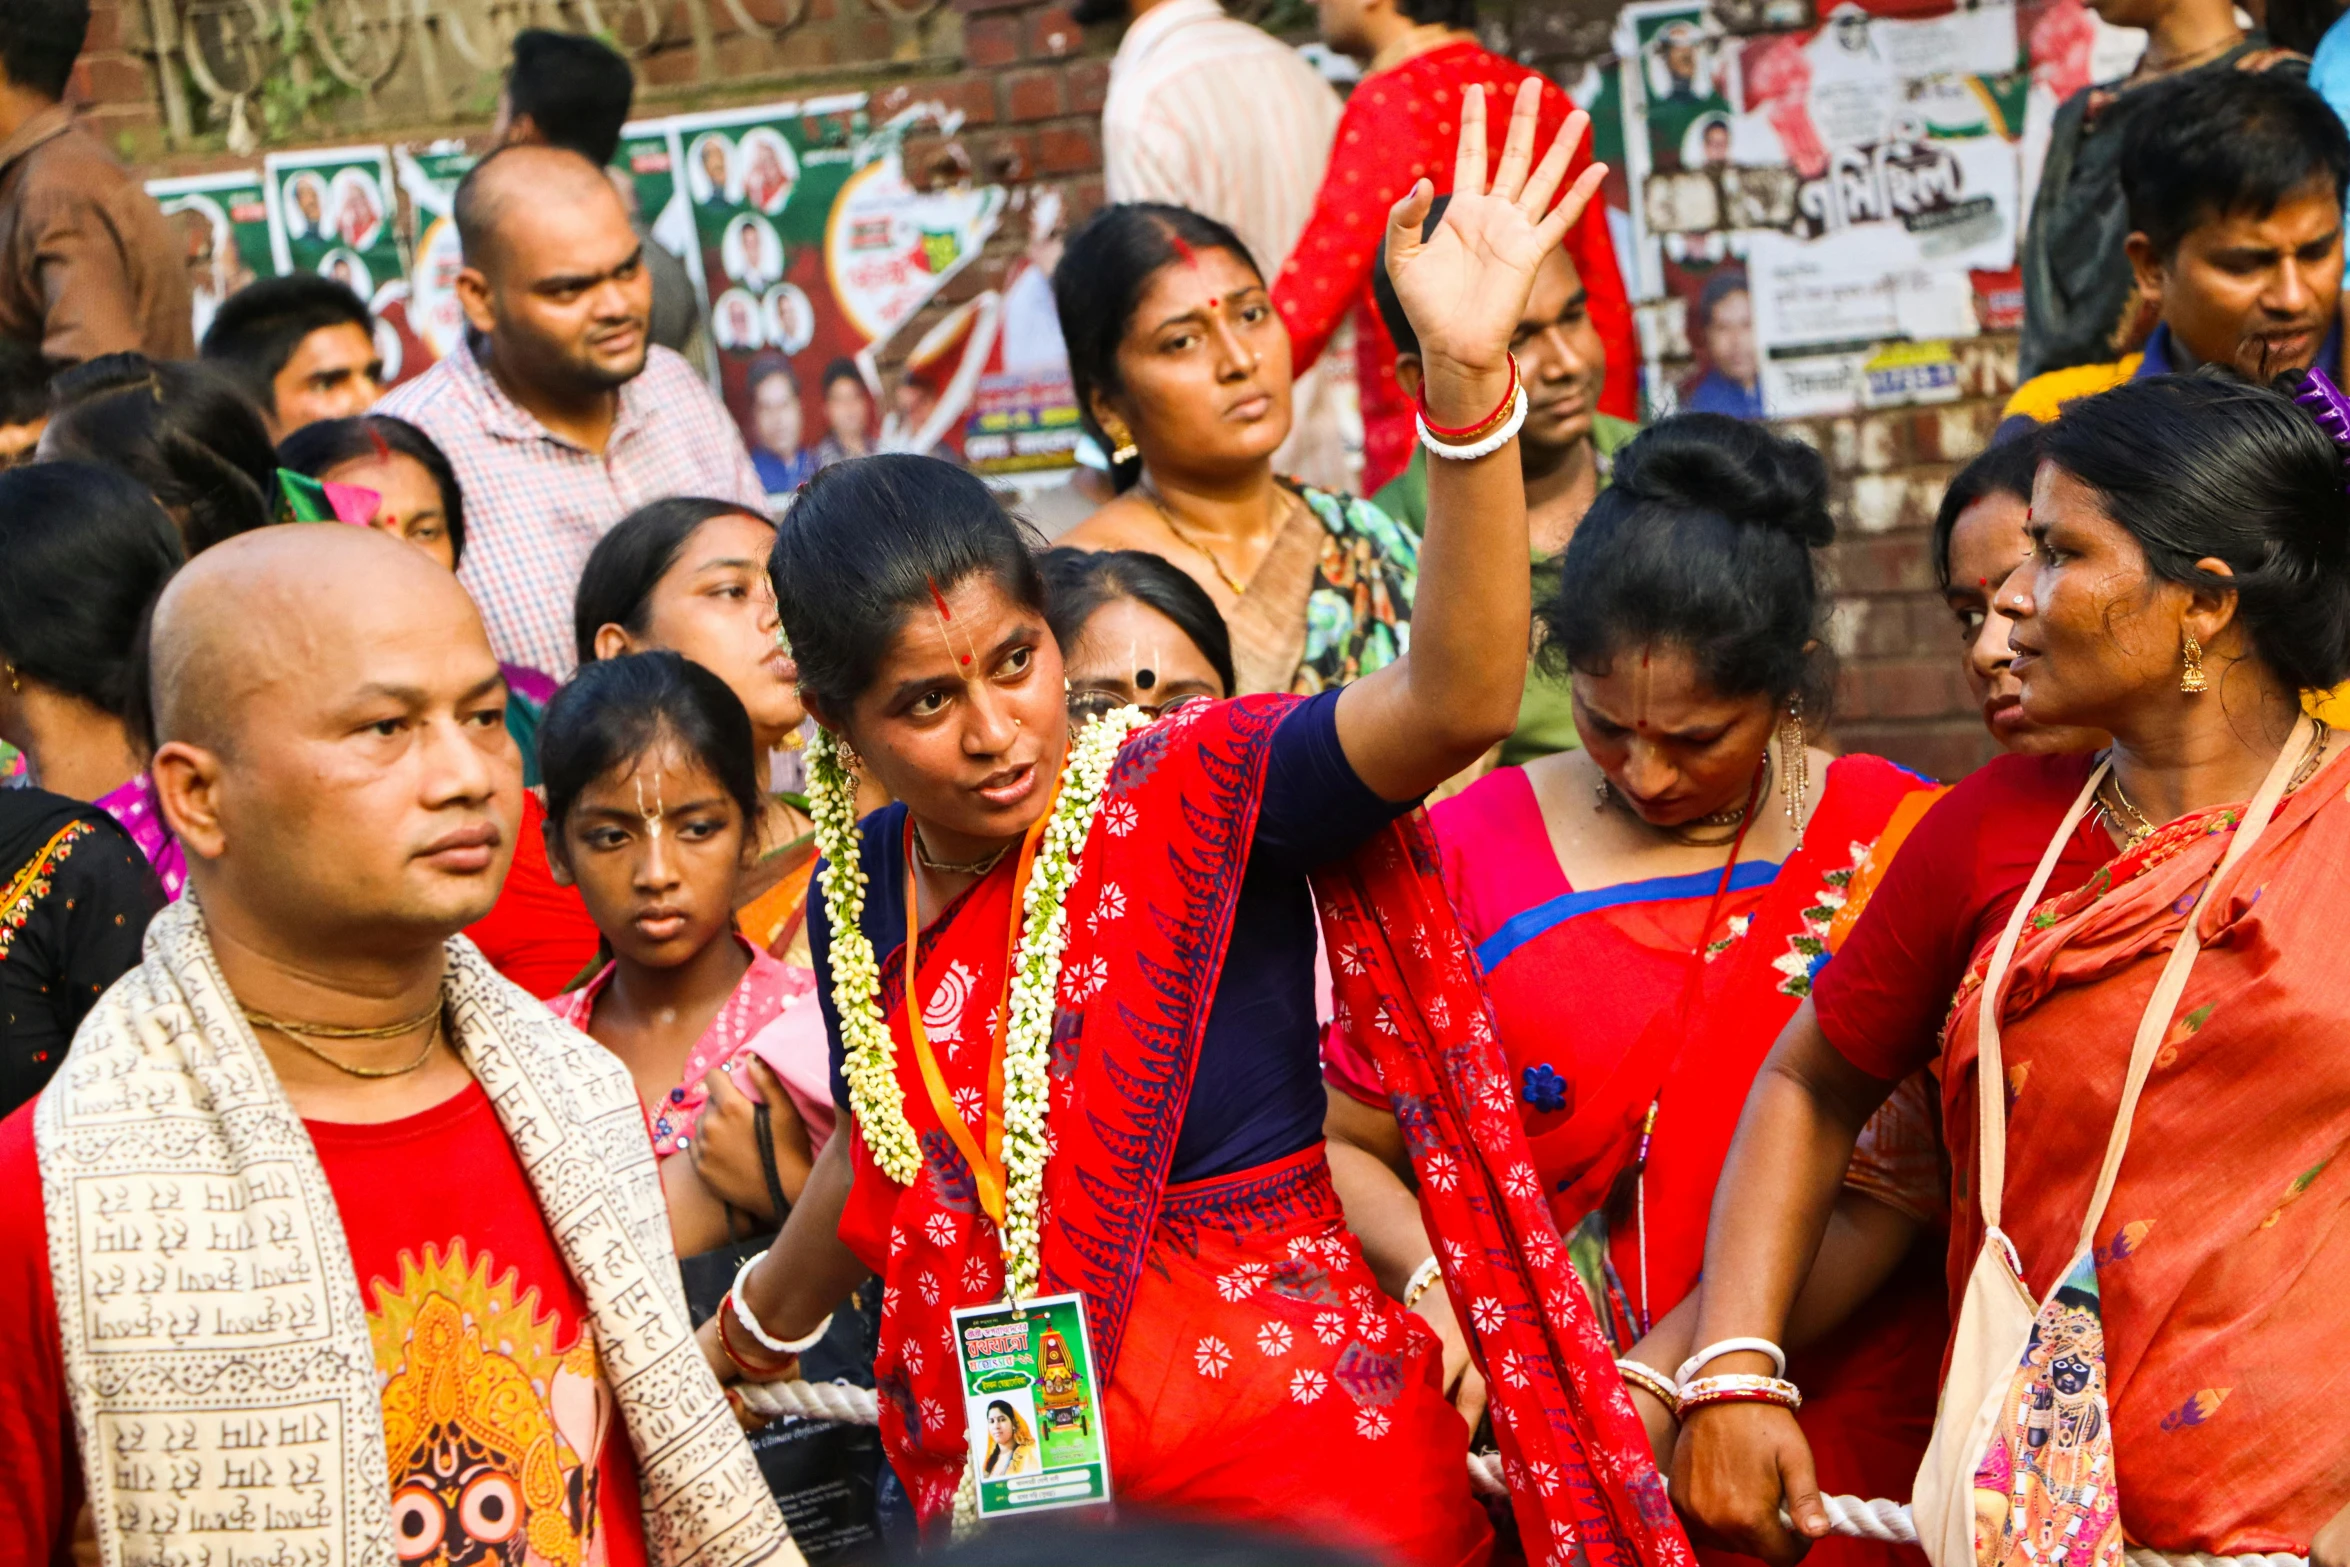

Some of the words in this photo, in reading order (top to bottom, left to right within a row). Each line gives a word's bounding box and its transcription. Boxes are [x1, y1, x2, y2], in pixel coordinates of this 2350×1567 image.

[476, 1042, 510, 1084] हरे
[146, 1181, 185, 1219] हरे
[92, 1224, 143, 1253] राम
[154, 1217, 188, 1259] हरे
[206, 1221, 257, 1253] राम
[264, 1209, 299, 1251] हरे
[175, 1257, 243, 1294] कृष्ण
[251, 1246, 312, 1292] कृष्ण
[603, 1239, 634, 1278] हरे
[88, 1264, 125, 1305] हरे
[133, 1261, 166, 1302] हरे
[608, 1277, 653, 1320] राम
[90, 1304, 164, 1342] कृष्ण
[165, 1305, 201, 1346] हरे
[212, 1297, 283, 1336] कृष्ण
[285, 1293, 317, 1337] हरे
[635, 1310, 673, 1351] हरे
[966, 1333, 1028, 1358] রথযাত্রা
[112, 1421, 148, 1461] हरे
[159, 1419, 199, 1458] हरे
[218, 1419, 269, 1452] राम
[277, 1412, 331, 1447] राम
[761, 1432, 792, 1448] Ultimate
[793, 1421, 831, 1440] Perfection
[168, 1460, 202, 1500] हरे
[218, 1456, 276, 1490] राम
[286, 1453, 324, 1495] हरे
[189, 1494, 257, 1534] कृष्ण
[263, 1490, 332, 1532] कृष्ण
